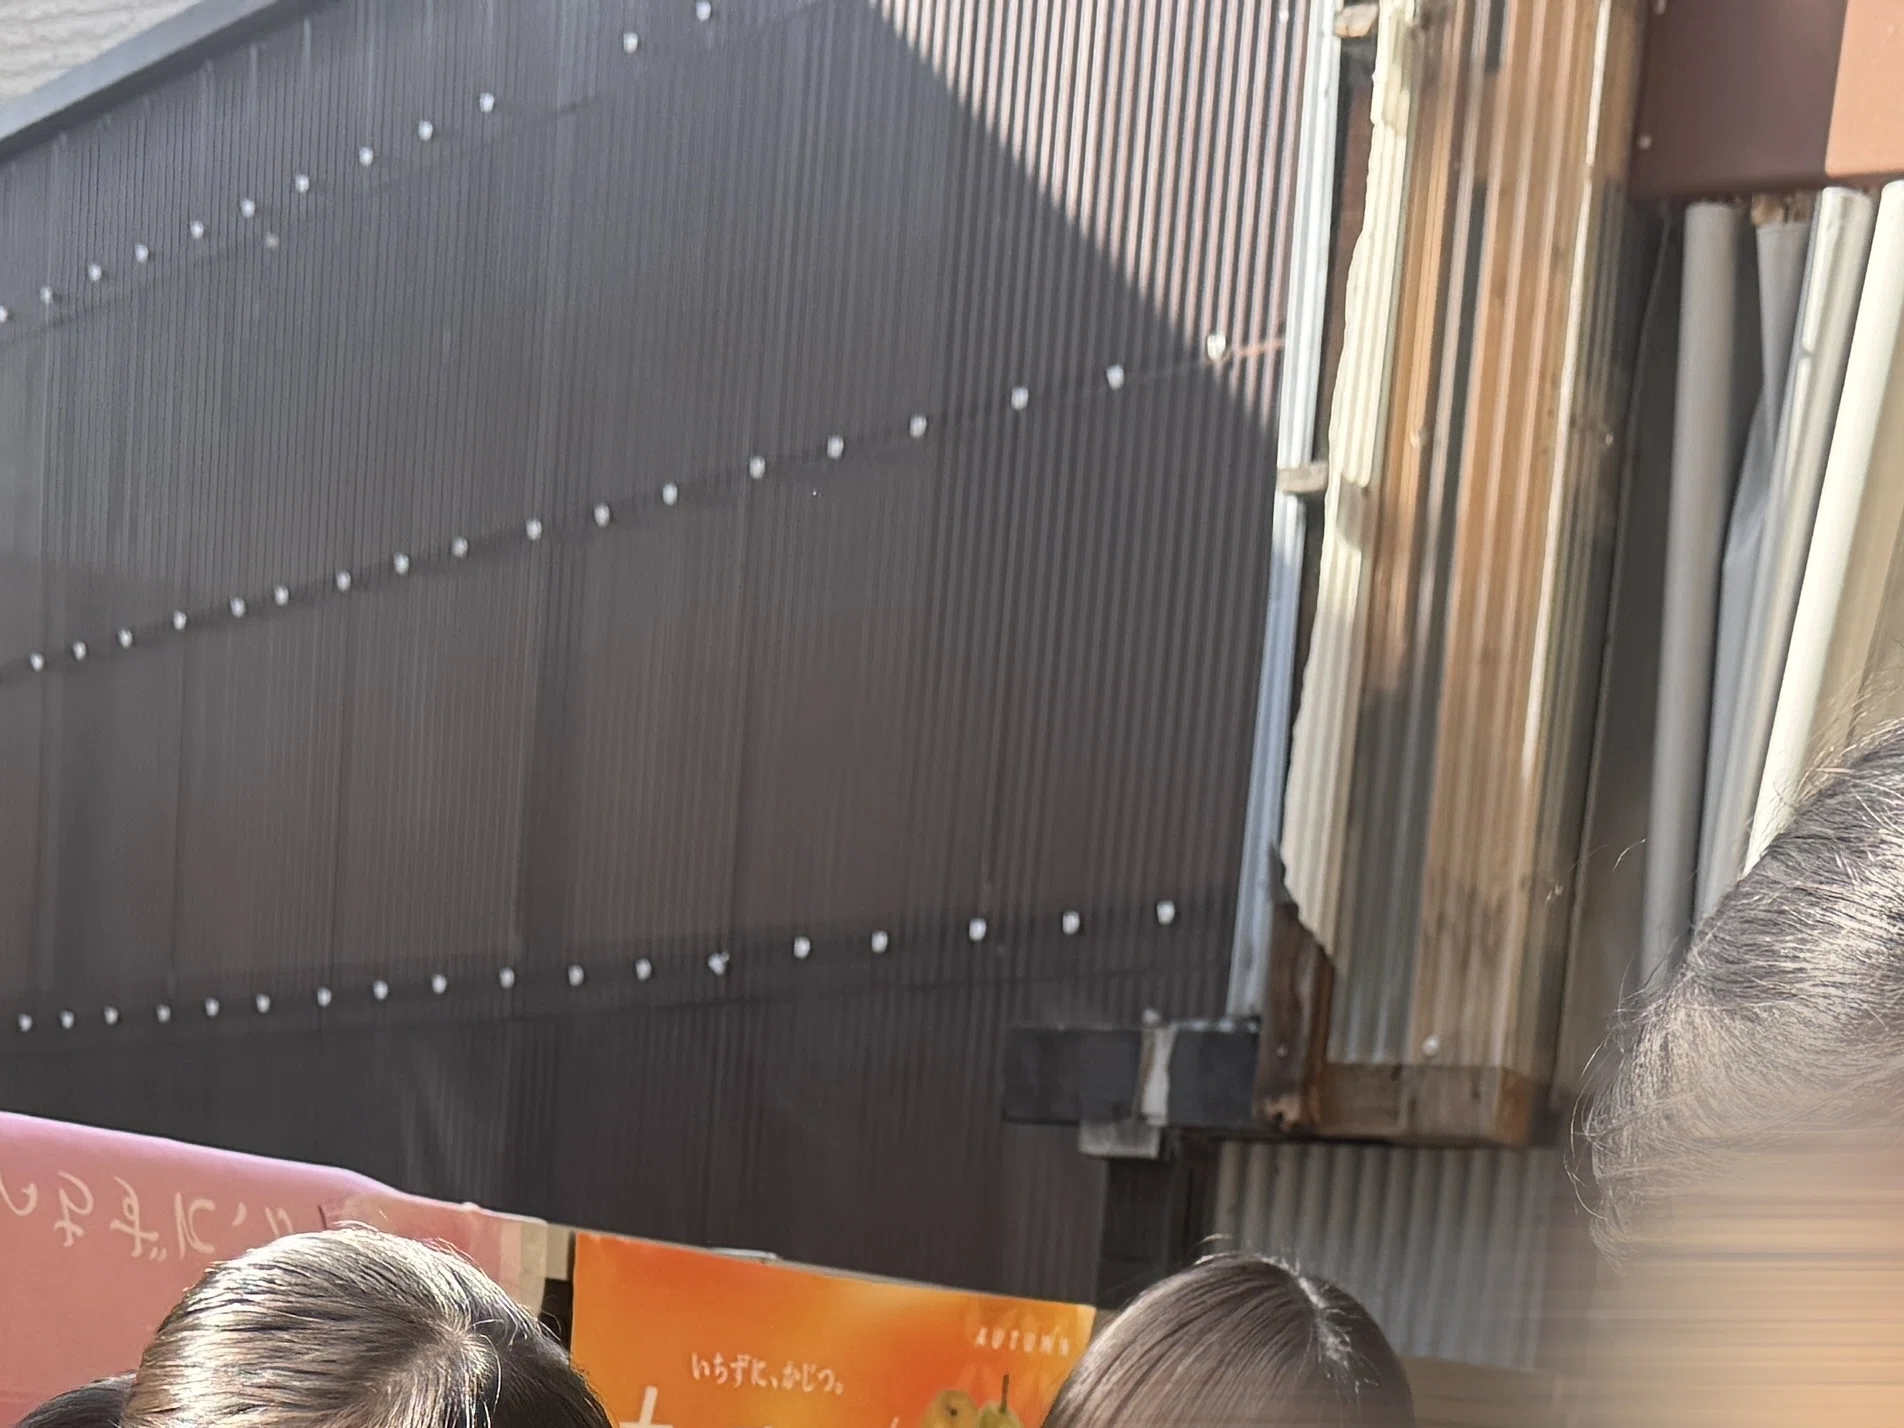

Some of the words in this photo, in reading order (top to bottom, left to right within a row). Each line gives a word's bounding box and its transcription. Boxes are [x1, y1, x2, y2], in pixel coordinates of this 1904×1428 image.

[691, 1352, 844, 1395] いちずに、かじつ。
